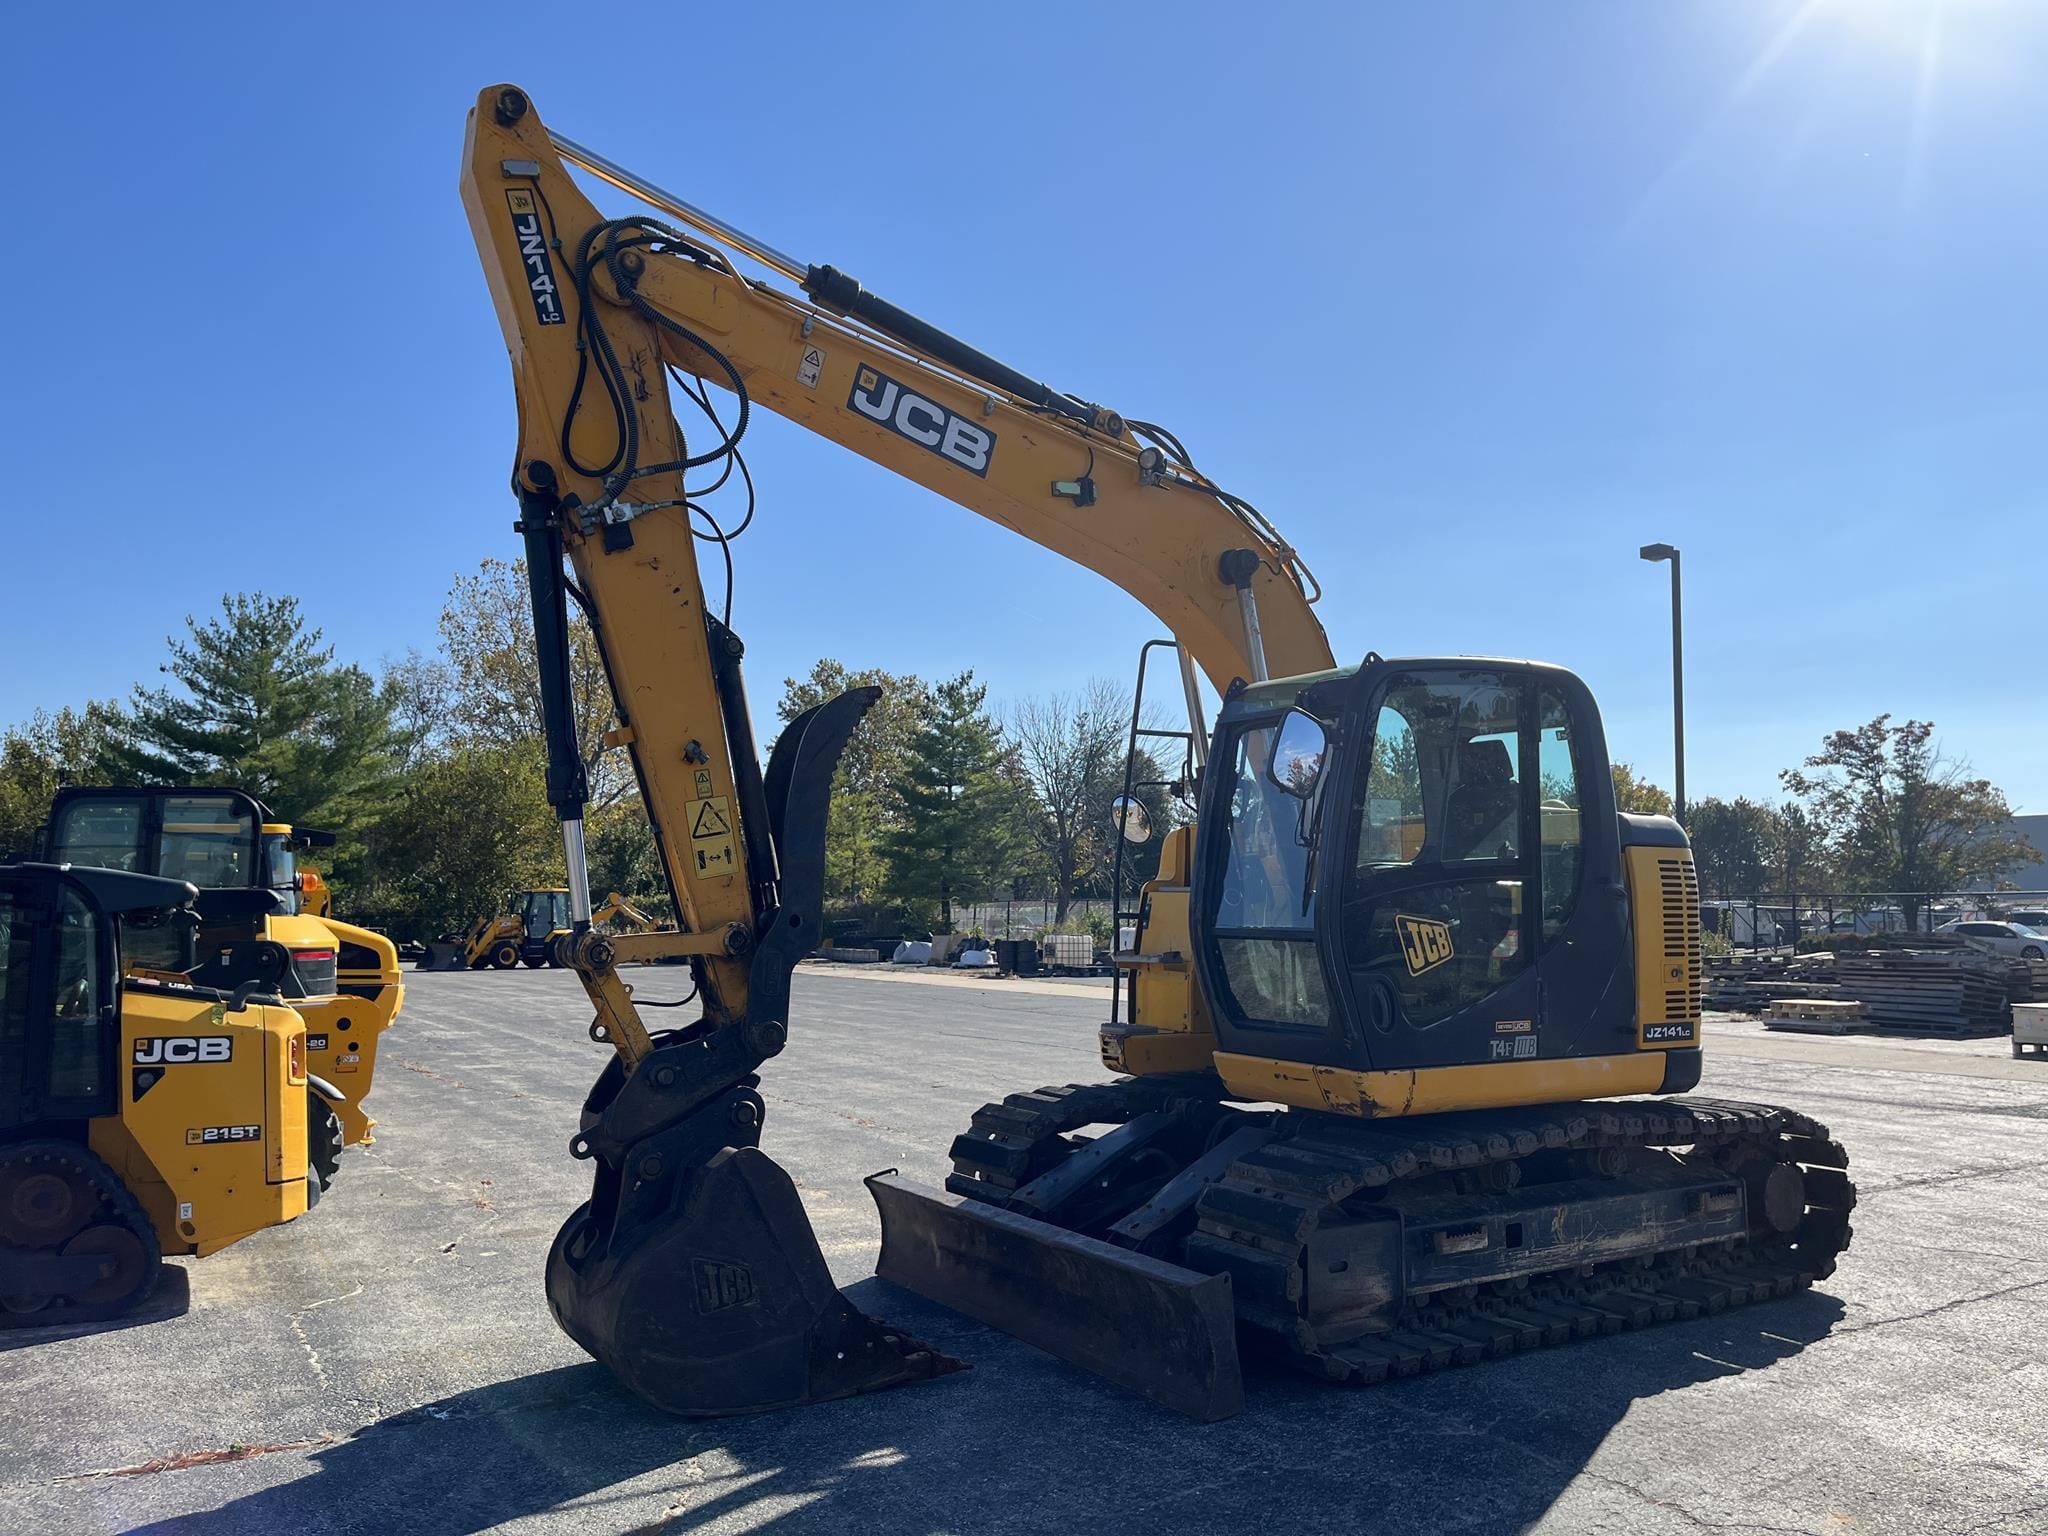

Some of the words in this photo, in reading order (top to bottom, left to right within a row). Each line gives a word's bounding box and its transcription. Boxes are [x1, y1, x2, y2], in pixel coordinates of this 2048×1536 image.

[853, 380, 991, 471] JCB
[1405, 921, 1451, 970] JCB
[167, 981, 194, 991] USA
[1514, 1022, 1529, 1030] JCB
[1645, 1026, 1691, 1039] JZ141LC
[134, 1037, 231, 1063] JCB
[1489, 1039, 1514, 1057] T4F
[203, 1126, 259, 1140] 215T
[701, 1263, 753, 1308] JCB
